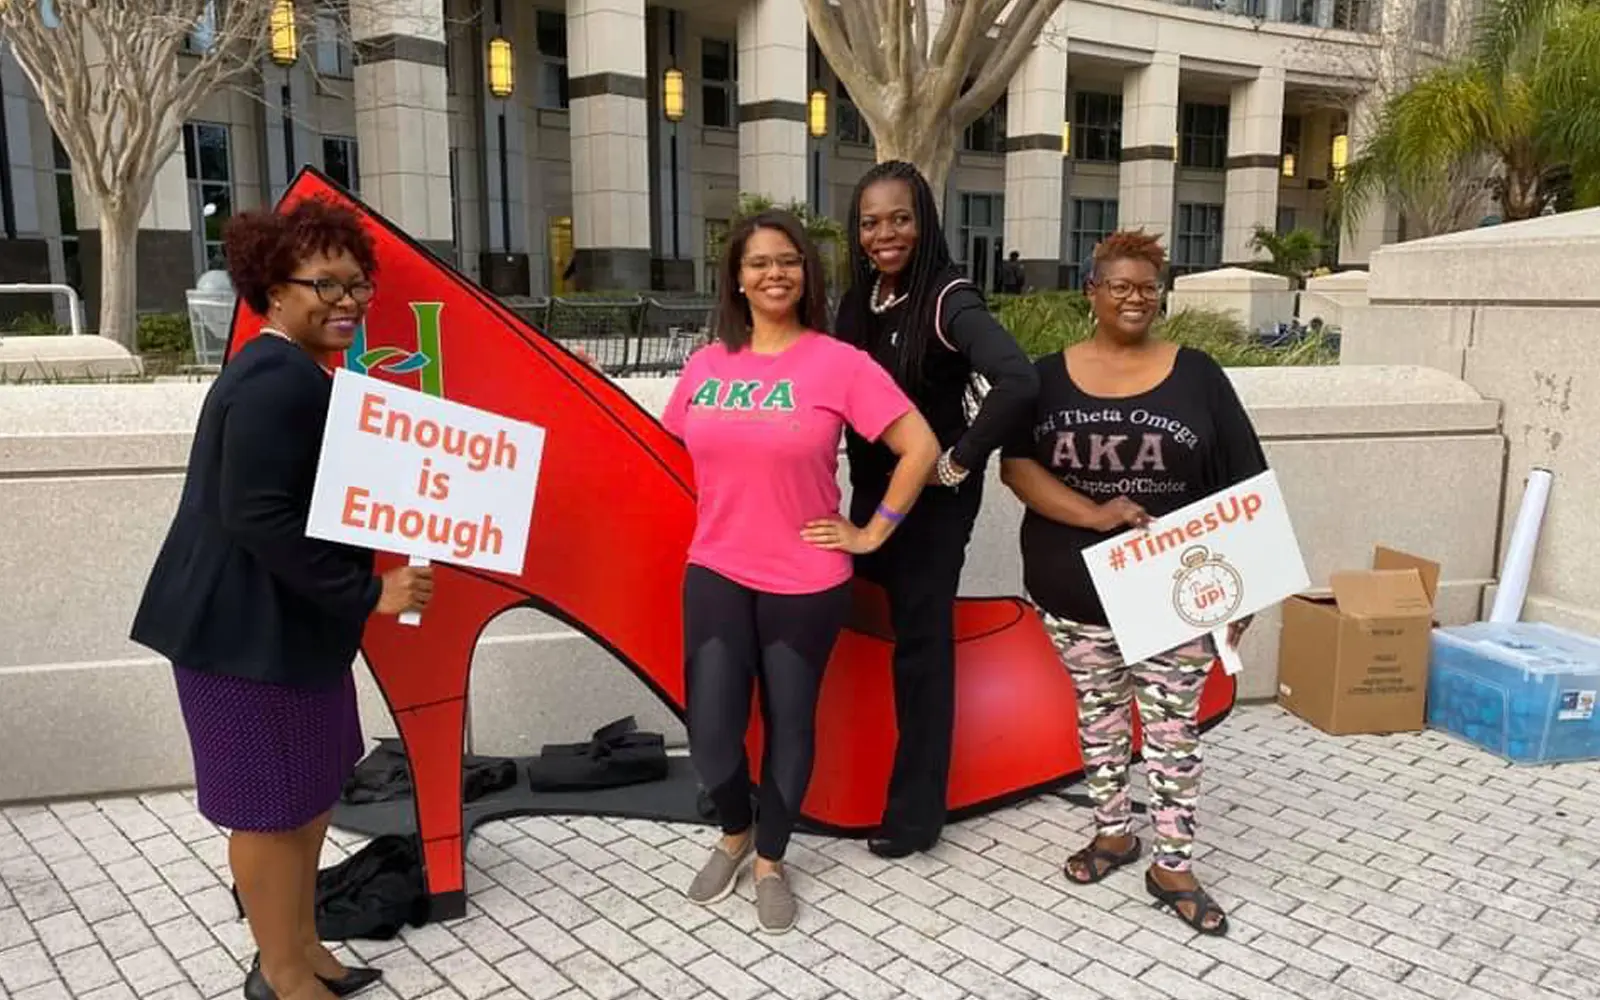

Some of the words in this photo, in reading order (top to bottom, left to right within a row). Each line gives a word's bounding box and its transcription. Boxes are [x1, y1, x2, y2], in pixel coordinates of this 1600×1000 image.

[358, 392, 517, 471] Enough
[1051, 431, 1166, 471] AKA
[1059, 408, 1123, 426] Theta
[1129, 409, 1199, 450] Omega
[417, 458, 450, 500] is
[340, 486, 503, 558] Enough
[1108, 493, 1263, 571] #TimesUp
